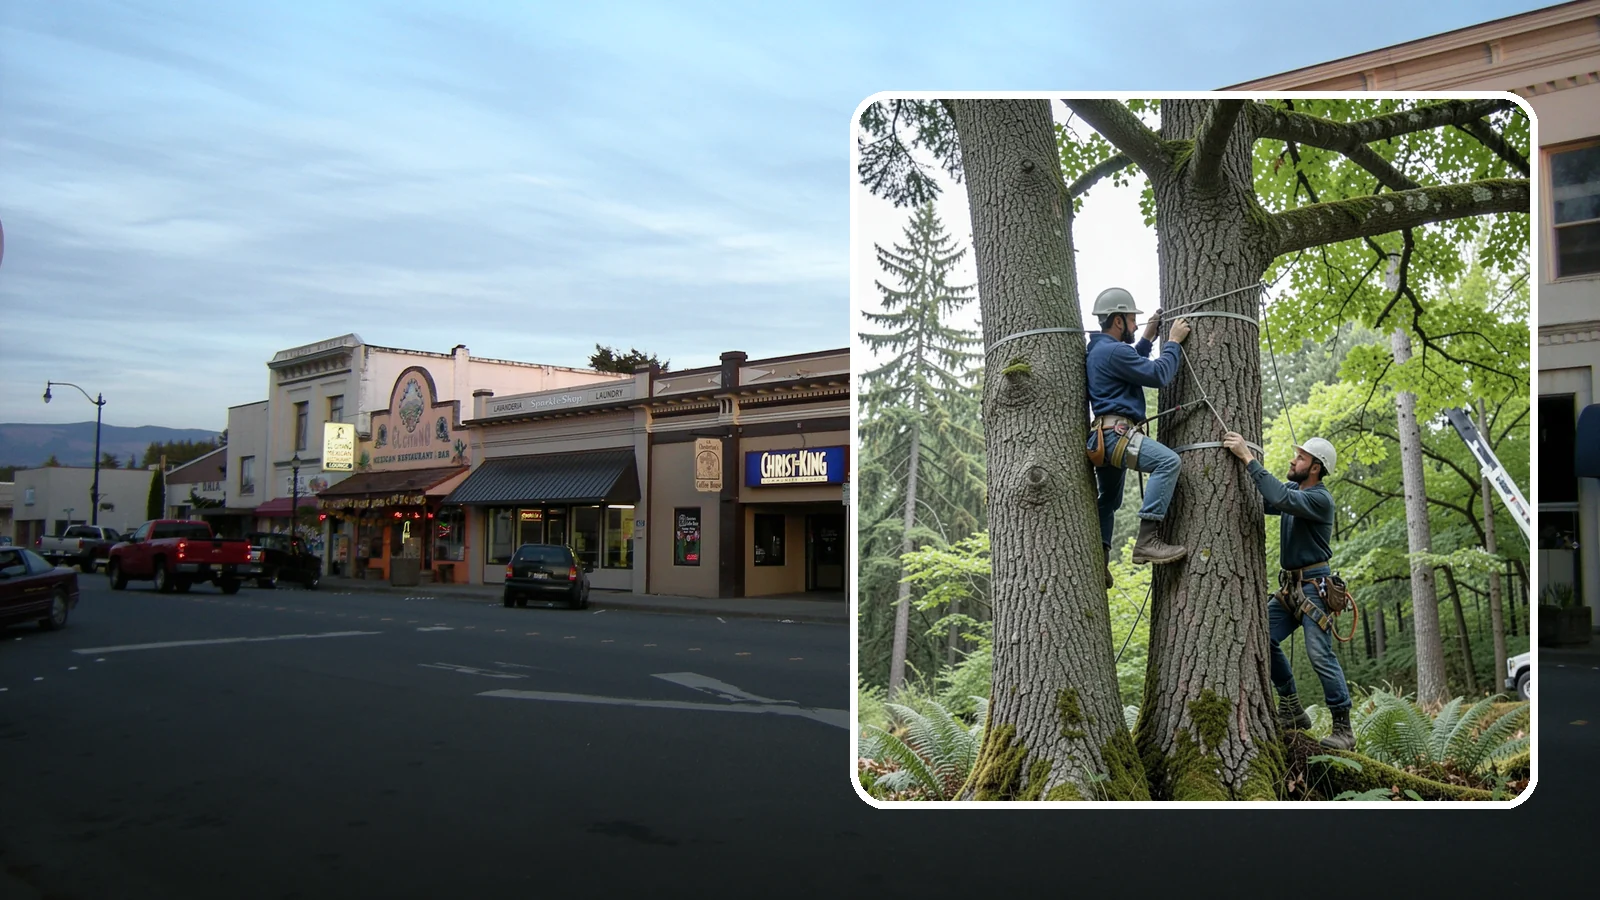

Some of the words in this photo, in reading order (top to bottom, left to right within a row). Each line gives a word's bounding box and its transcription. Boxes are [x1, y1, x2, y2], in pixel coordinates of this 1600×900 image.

[530, 398, 561, 409] Sparkle
[561, 394, 583, 405] Shop
[595, 389, 623, 400] LAUNDRY
[493, 402, 522, 412] LAVANDERIA
[373, 455, 396, 464] MEXICAN
[397, 451, 433, 462] RESTAURANT
[438, 450, 450, 459] BAR
[761, 452, 797, 478] CHRIST
[799, 450, 827, 476] KING
